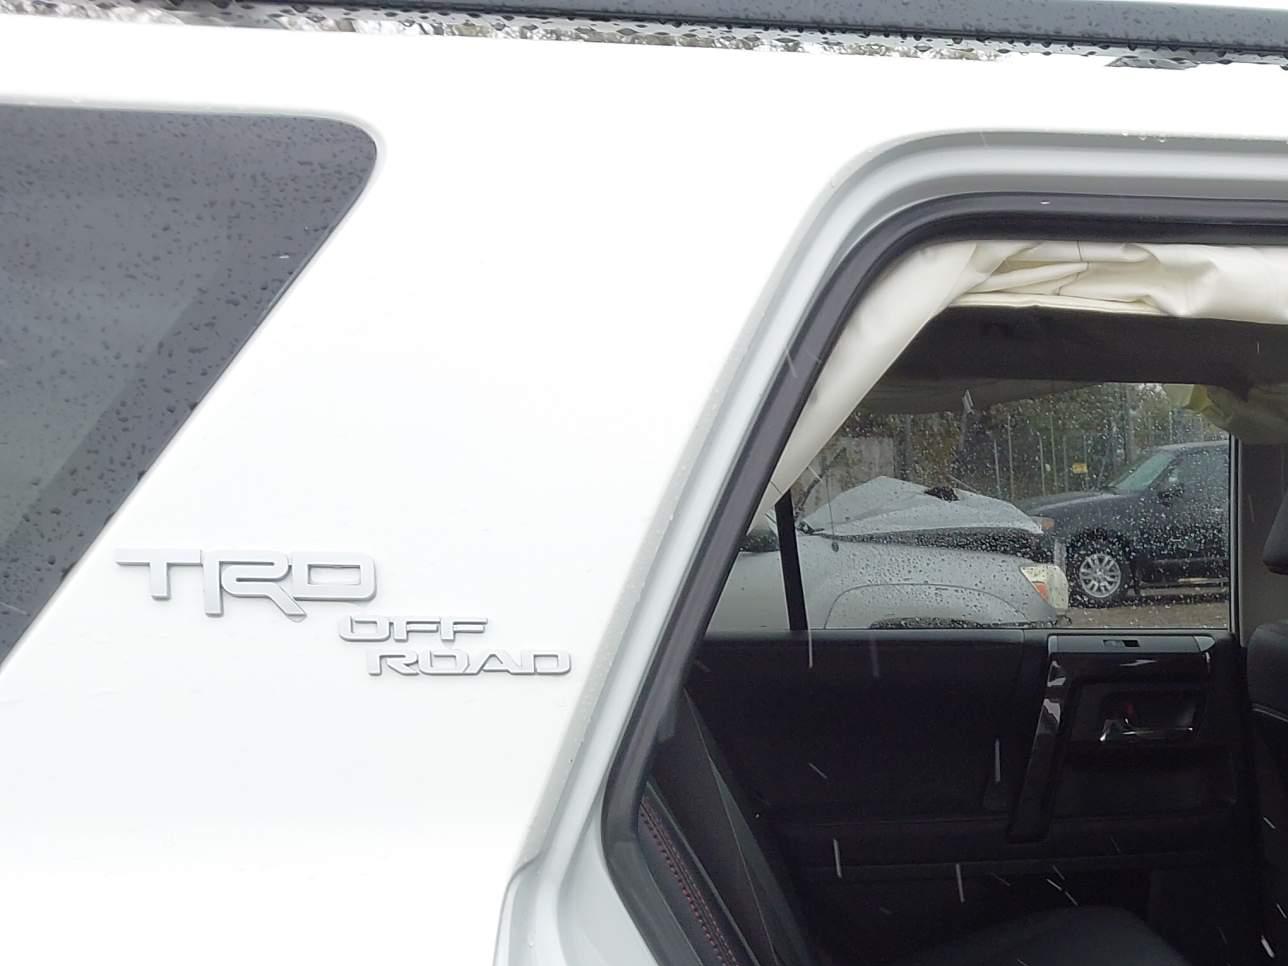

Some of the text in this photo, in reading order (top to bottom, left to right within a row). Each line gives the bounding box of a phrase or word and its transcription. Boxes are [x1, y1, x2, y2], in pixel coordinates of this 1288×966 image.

[116, 549, 377, 617] TRD
[339, 615, 488, 643] OFF
[368, 648, 572, 676] ROAD
